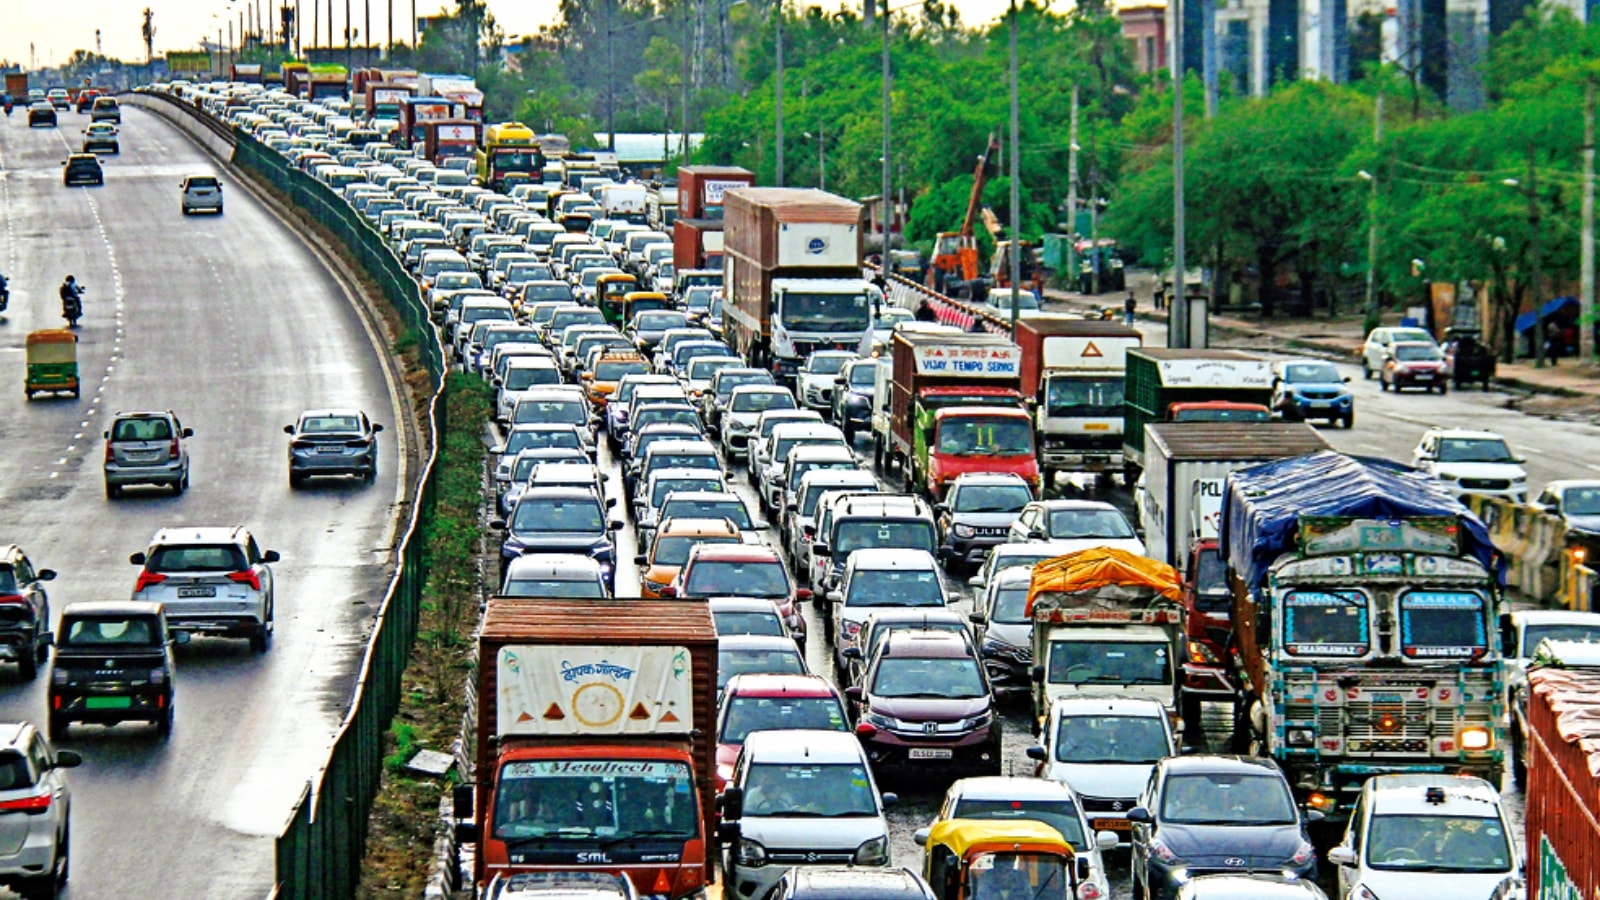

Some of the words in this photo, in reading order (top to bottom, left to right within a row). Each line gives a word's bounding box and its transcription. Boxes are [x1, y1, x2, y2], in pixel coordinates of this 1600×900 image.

[923, 360, 947, 370] VIJAY
[953, 361, 983, 371] TEMPO
[1201, 482, 1222, 496] PCL
[1415, 646, 1472, 656] MUMTAJ
[550, 762, 653, 774] Metaltech
[576, 852, 613, 863] SML
